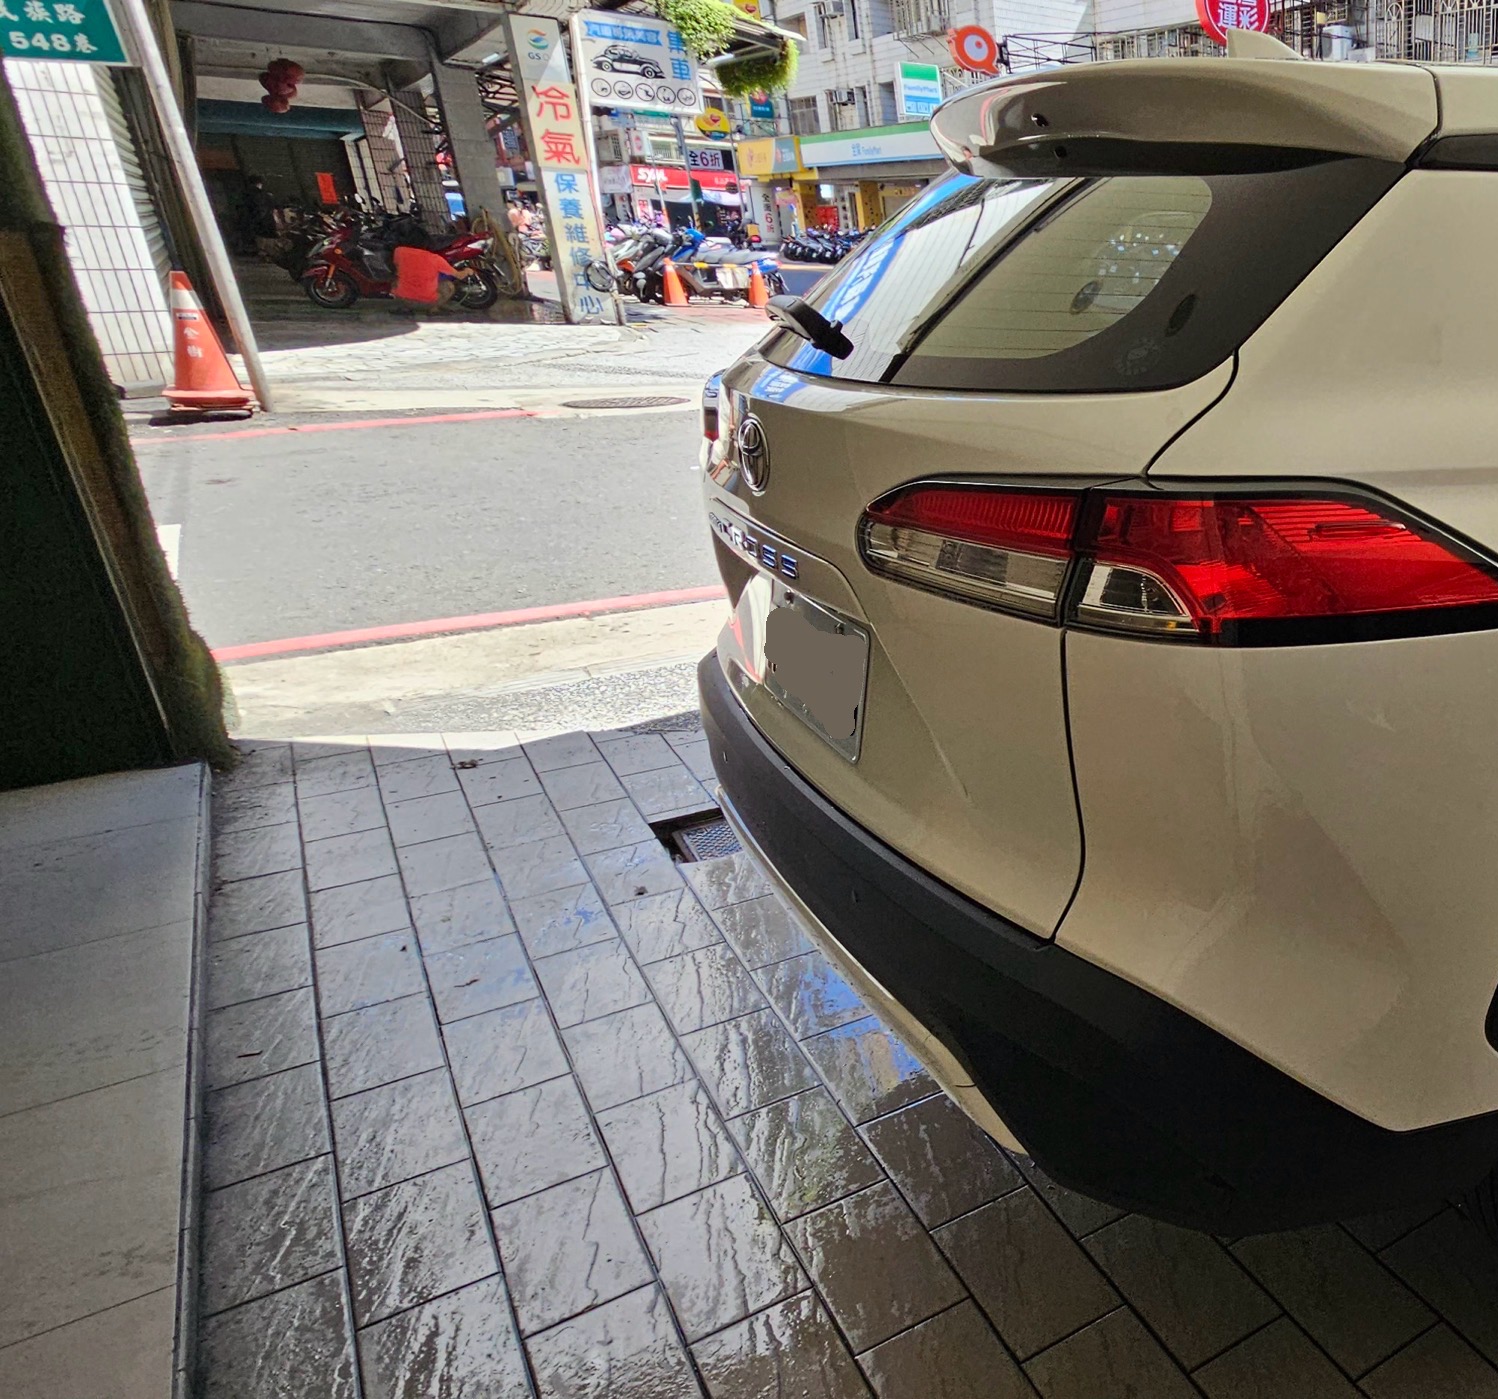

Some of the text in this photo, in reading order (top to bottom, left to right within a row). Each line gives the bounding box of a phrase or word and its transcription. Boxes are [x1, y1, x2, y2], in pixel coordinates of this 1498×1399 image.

[1218, 3, 1259, 31] 運彩
[8, 31, 98, 53] 548巷
[532, 85, 580, 165] 冷氣
[688, 150, 720, 167] 全6折
[554, 172, 605, 315] 保養維修中心
